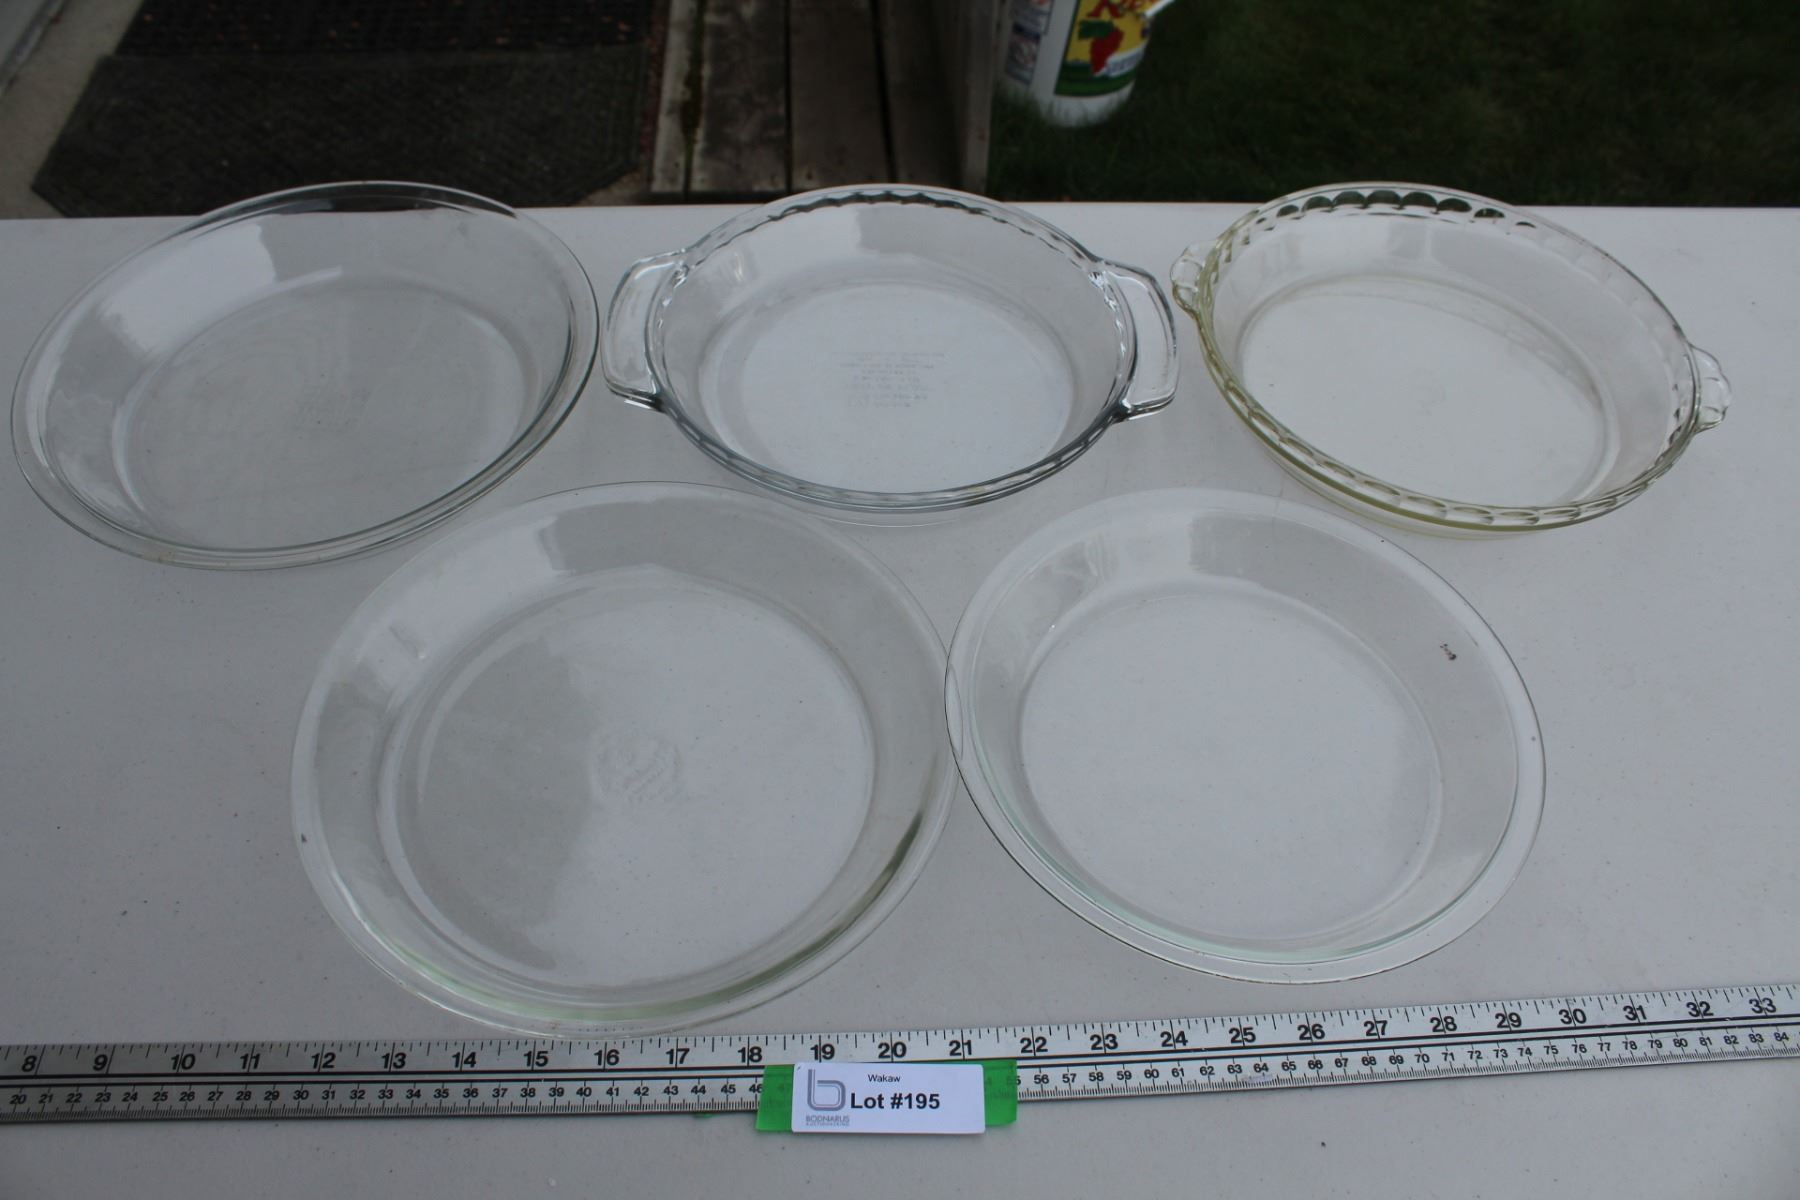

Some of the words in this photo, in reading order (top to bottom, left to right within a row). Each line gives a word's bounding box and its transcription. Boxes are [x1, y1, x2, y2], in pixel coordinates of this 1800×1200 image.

[22, 1055, 37, 1072] 8
[93, 1055, 108, 1071] 9
[171, 1054, 195, 1070] 10
[240, 1053, 260, 1069] 11
[312, 1053, 336, 1069] 12
[382, 1053, 406, 1069] 13
[452, 1052, 477, 1068] 14
[524, 1051, 548, 1067] 15
[594, 1049, 619, 1066] 16
[666, 1048, 690, 1064] 17
[738, 1046, 762, 1063] 18
[810, 1044, 835, 1060] 19
[878, 1042, 907, 1058] 20
[949, 1040, 972, 1056] 21
[1020, 1037, 1048, 1053] 22
[1090, 1033, 1118, 1050] 23
[1160, 1031, 1188, 1047] 24
[1229, 1027, 1256, 1043] 25
[1297, 1024, 1325, 1040] 26
[1364, 1020, 1388, 1036] 27
[1430, 1016, 1457, 1032] 28
[1495, 1012, 1522, 1028] 29
[1559, 1008, 1586, 1024] 30
[1623, 1005, 1647, 1021] 31
[1686, 1001, 1713, 1017] 32
[1750, 998, 1776, 1013] 33
[10, 1094, 26, 1104] 20
[39, 1094, 53, 1103] 21
[66, 1093, 82, 1103] 22
[95, 1092, 111, 1102] 23
[122, 1092, 138, 1102] 24
[153, 1092, 168, 1101] 25
[179, 1092, 195, 1101] 26
[208, 1091, 223, 1100] 27
[236, 1091, 252, 1100] 28
[264, 1090, 279, 1100] 29
[293, 1090, 309, 1100] 30
[322, 1090, 335, 1099] 31
[350, 1090, 365, 1099] 32
[378, 1089, 393, 1099] 33
[406, 1089, 421, 1098] 34
[434, 1089, 449, 1098] 35
[463, 1088, 478, 1098] 36
[492, 1088, 508, 1098] 37
[521, 1088, 536, 1097] 38
[549, 1087, 564, 1097] 39
[576, 1087, 592, 1096] 40
[606, 1087, 619, 1096] 41
[634, 1087, 649, 1096] 42
[664, 1086, 679, 1095] 43
[691, 1085, 706, 1094] 44
[721, 1084, 736, 1093] 45
[1034, 1074, 1049, 1084] 56
[1062, 1073, 1076, 1083] 57
[1089, 1072, 1104, 1081] 58
[1117, 1071, 1132, 1080] 59
[1144, 1069, 1159, 1078] 60
[1172, 1068, 1185, 1077] 61
[1200, 1066, 1215, 1075] 62
[1228, 1064, 1242, 1073] 63
[1254, 1063, 1268, 1072] 64
[1282, 1061, 1296, 1071] 65
[1308, 1060, 1323, 1069] 66
[1335, 1058, 1348, 1068] 67
[1362, 1057, 1377, 1066] 68
[1389, 1055, 1404, 1064] 69
[1415, 1054, 1429, 1063] 70
[1442, 1052, 1454, 1061] 71
[1468, 1051, 1482, 1059] 72
[1493, 1049, 1508, 1058] 73
[1518, 1047, 1532, 1056] 74
[1544, 1045, 1559, 1055] 75
[1572, 1044, 1587, 1053] 76
[1598, 1042, 1611, 1051] 77
[1622, 1041, 1637, 1050] 78
[1648, 1039, 1662, 1048] 79
[1673, 1038, 1688, 1047] 80
[1700, 1037, 1712, 1046] 81
[1724, 1035, 1739, 1045] 82
[1748, 1034, 1764, 1043] 83
[1774, 1032, 1789, 1041] 84
[868, 1074, 901, 1083] Wakaw
[850, 1093, 884, 1109] Lot
[890, 1093, 940, 1109] #195
